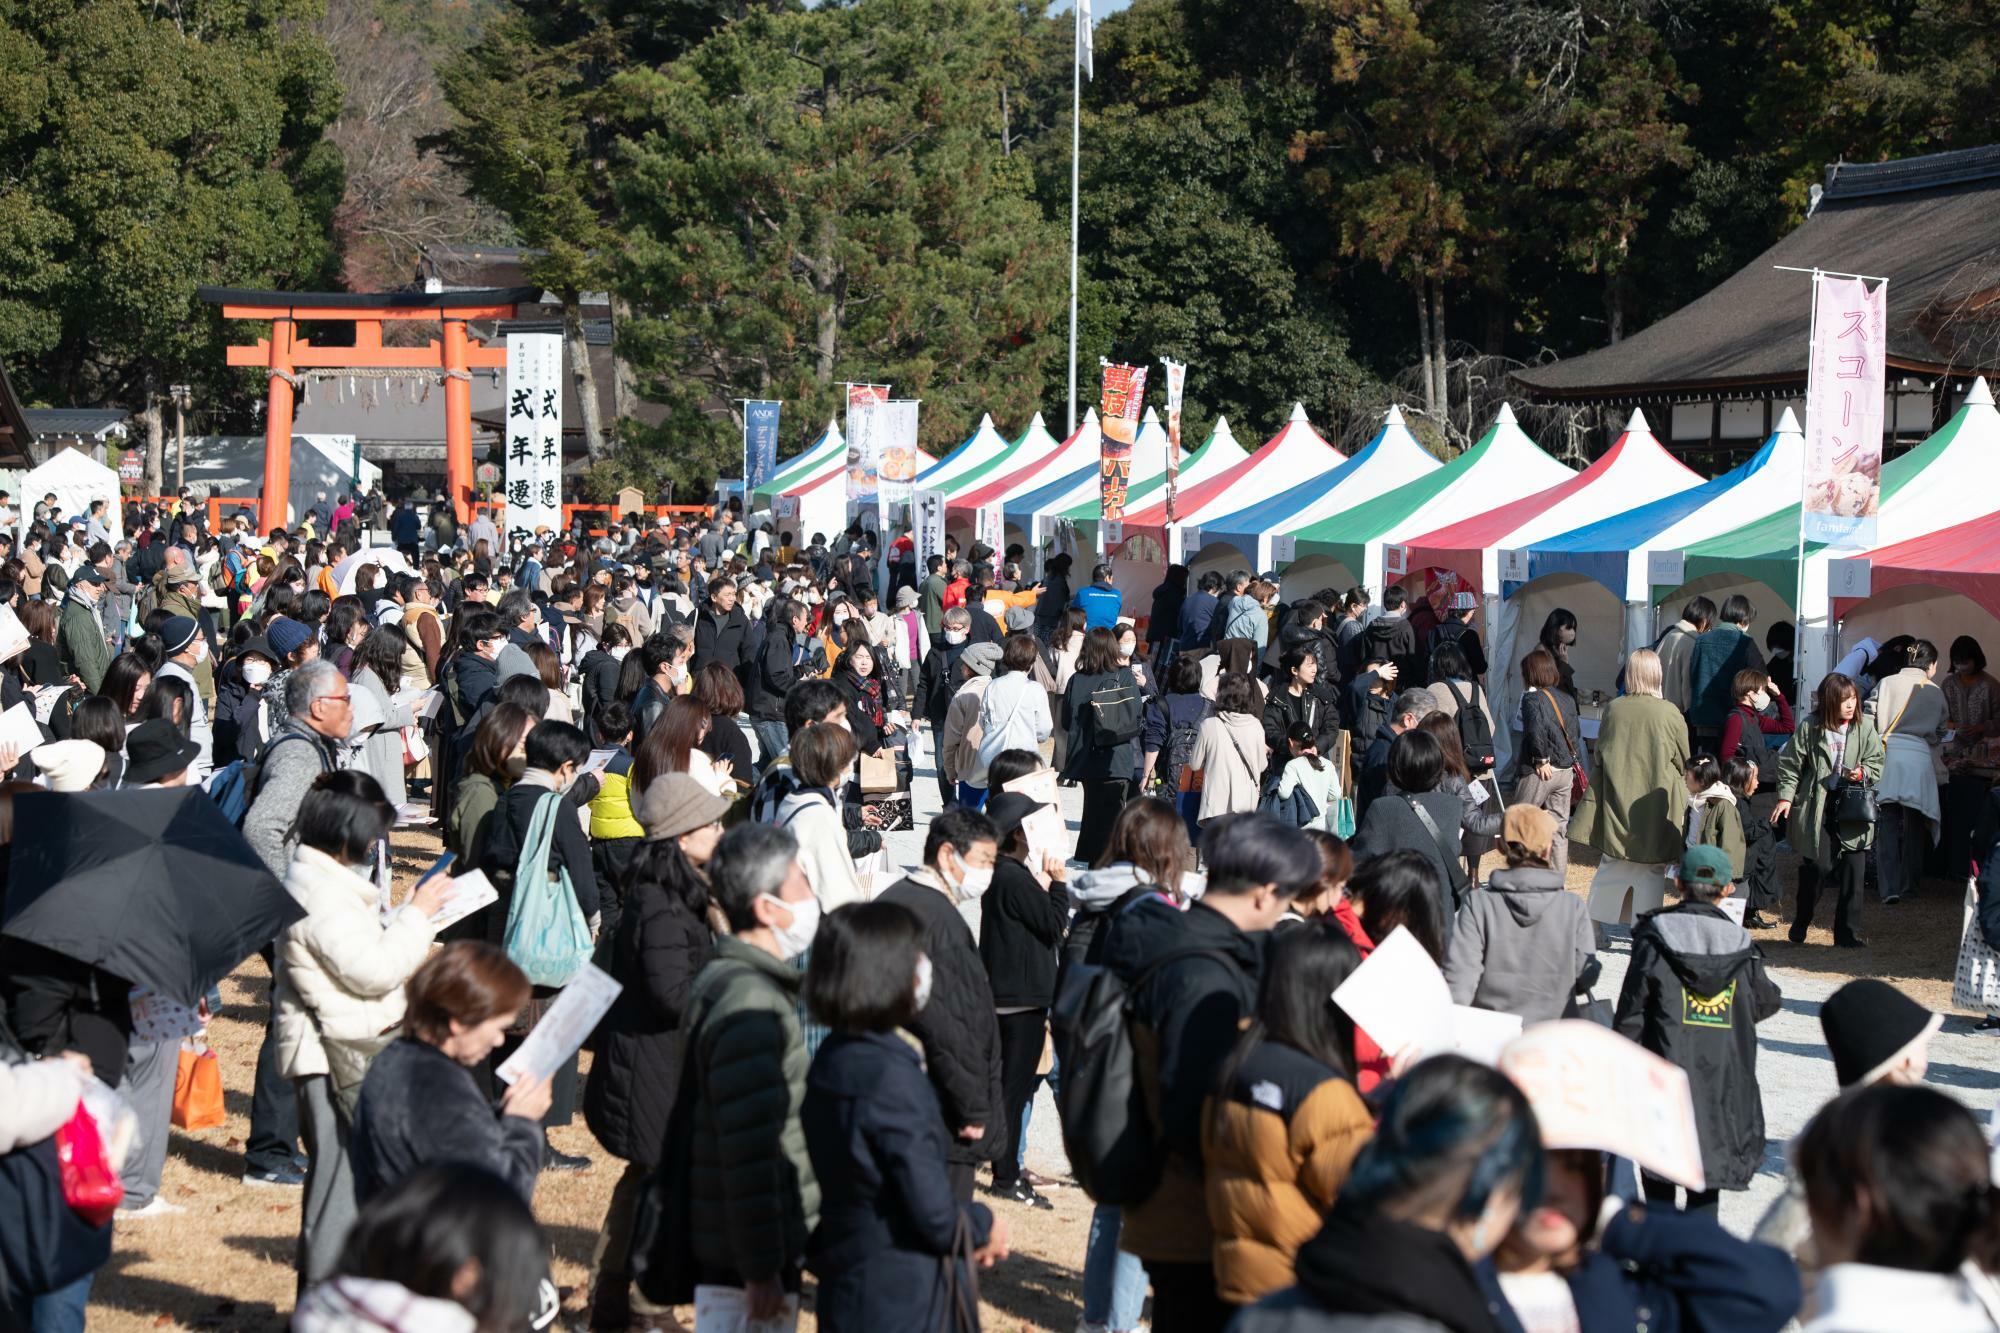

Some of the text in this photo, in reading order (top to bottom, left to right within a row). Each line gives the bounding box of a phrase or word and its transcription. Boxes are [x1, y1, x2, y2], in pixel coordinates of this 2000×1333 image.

[752, 409, 775, 418] ANDE
[1832, 311, 1867, 465] スコーン
[541, 389, 557, 548] 式年遷
